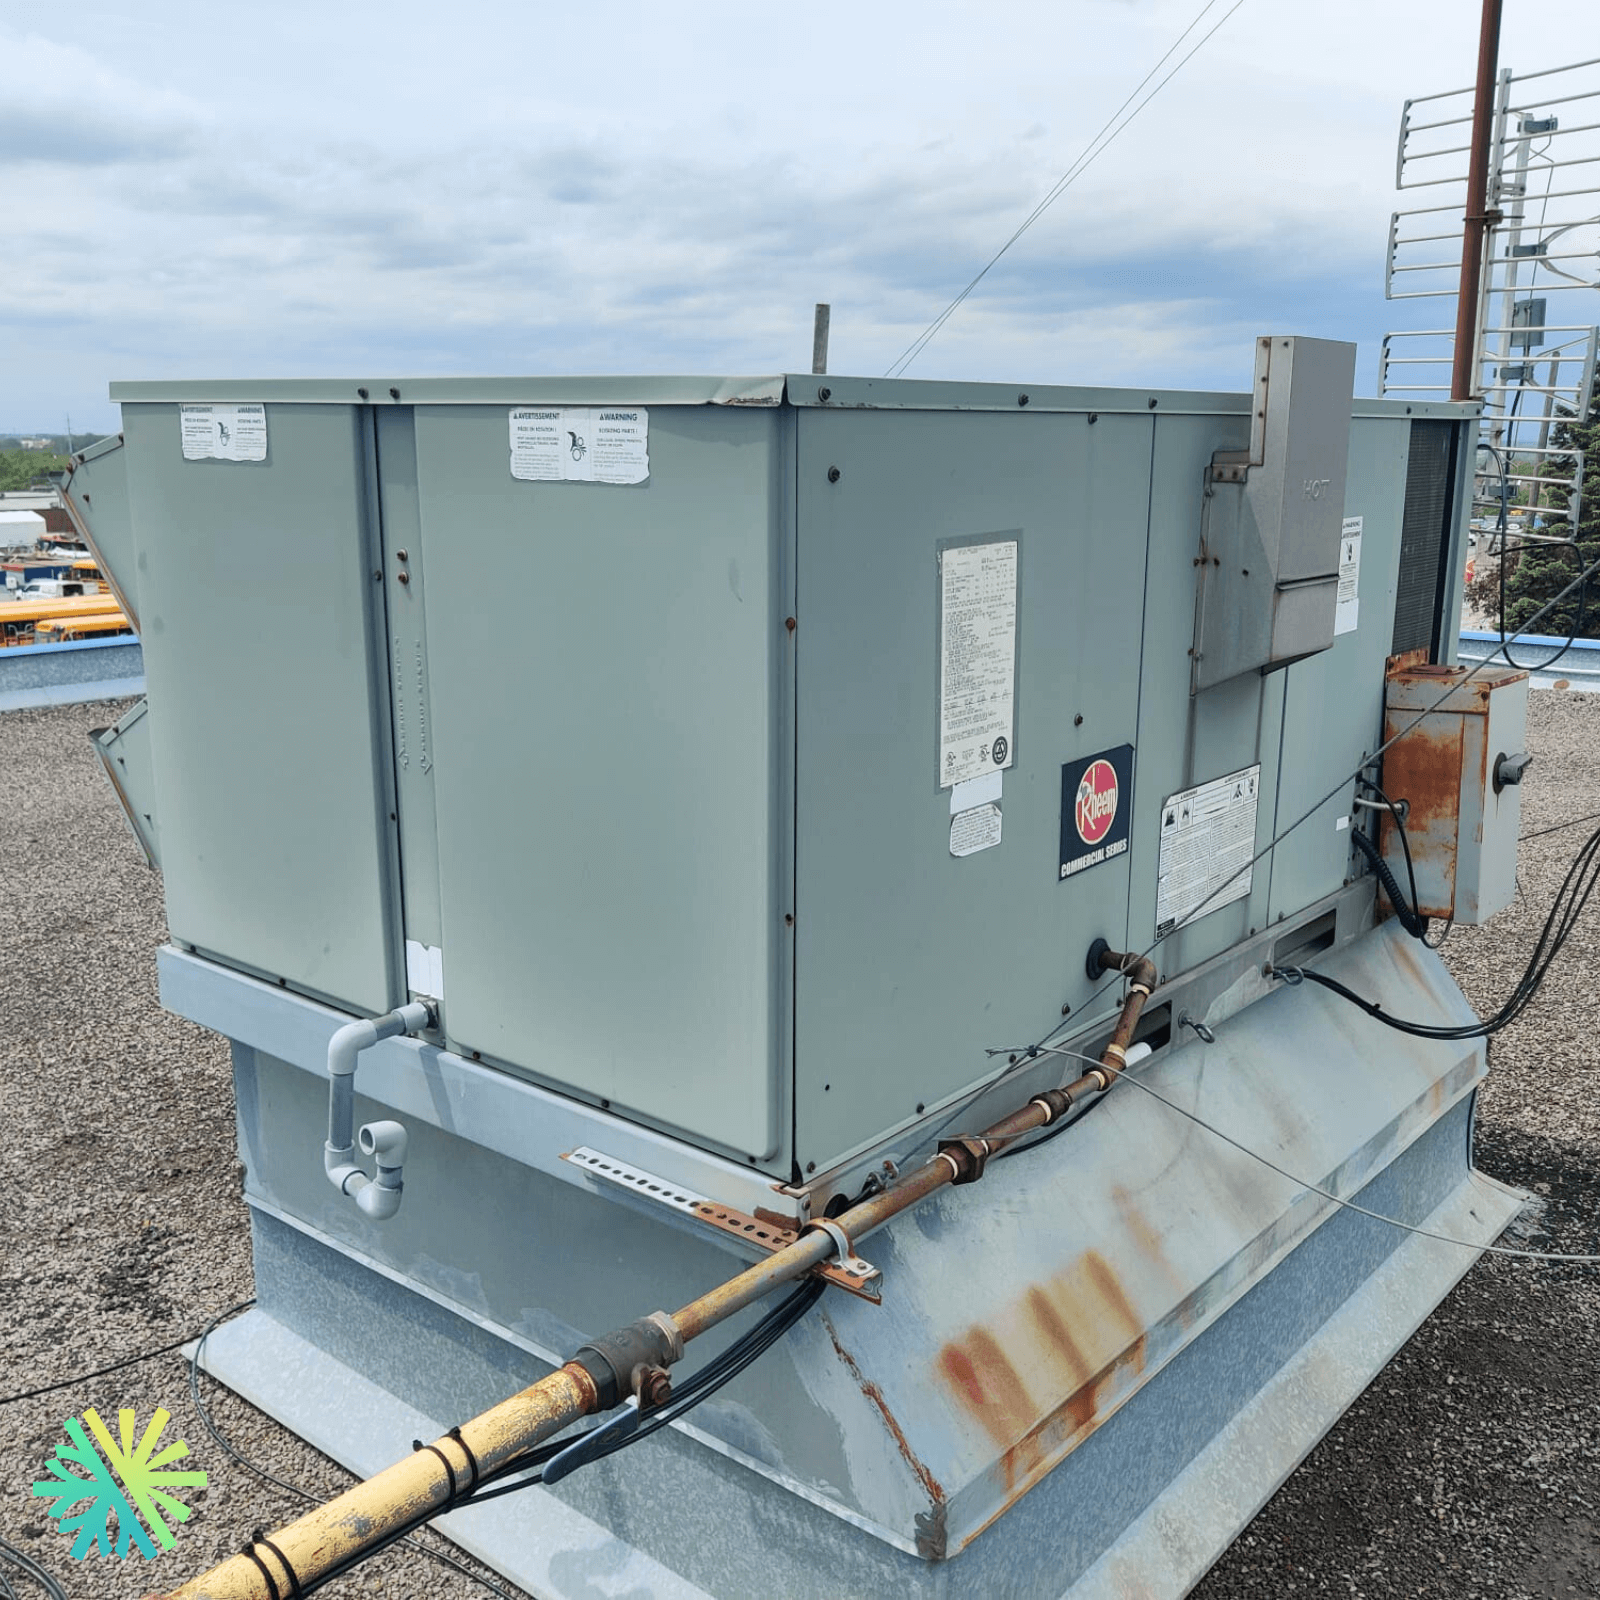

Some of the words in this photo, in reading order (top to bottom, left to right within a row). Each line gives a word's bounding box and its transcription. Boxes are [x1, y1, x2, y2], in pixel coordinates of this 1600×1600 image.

[518, 412, 560, 420] AVERTISSEMENT
[604, 413, 638, 421] WARNING
[1303, 479, 1331, 500] HOT
[1077, 766, 1116, 832] Rheem
[1061, 847, 1105, 878] COMMERCIAL
[1105, 838, 1128, 859] SERIES
